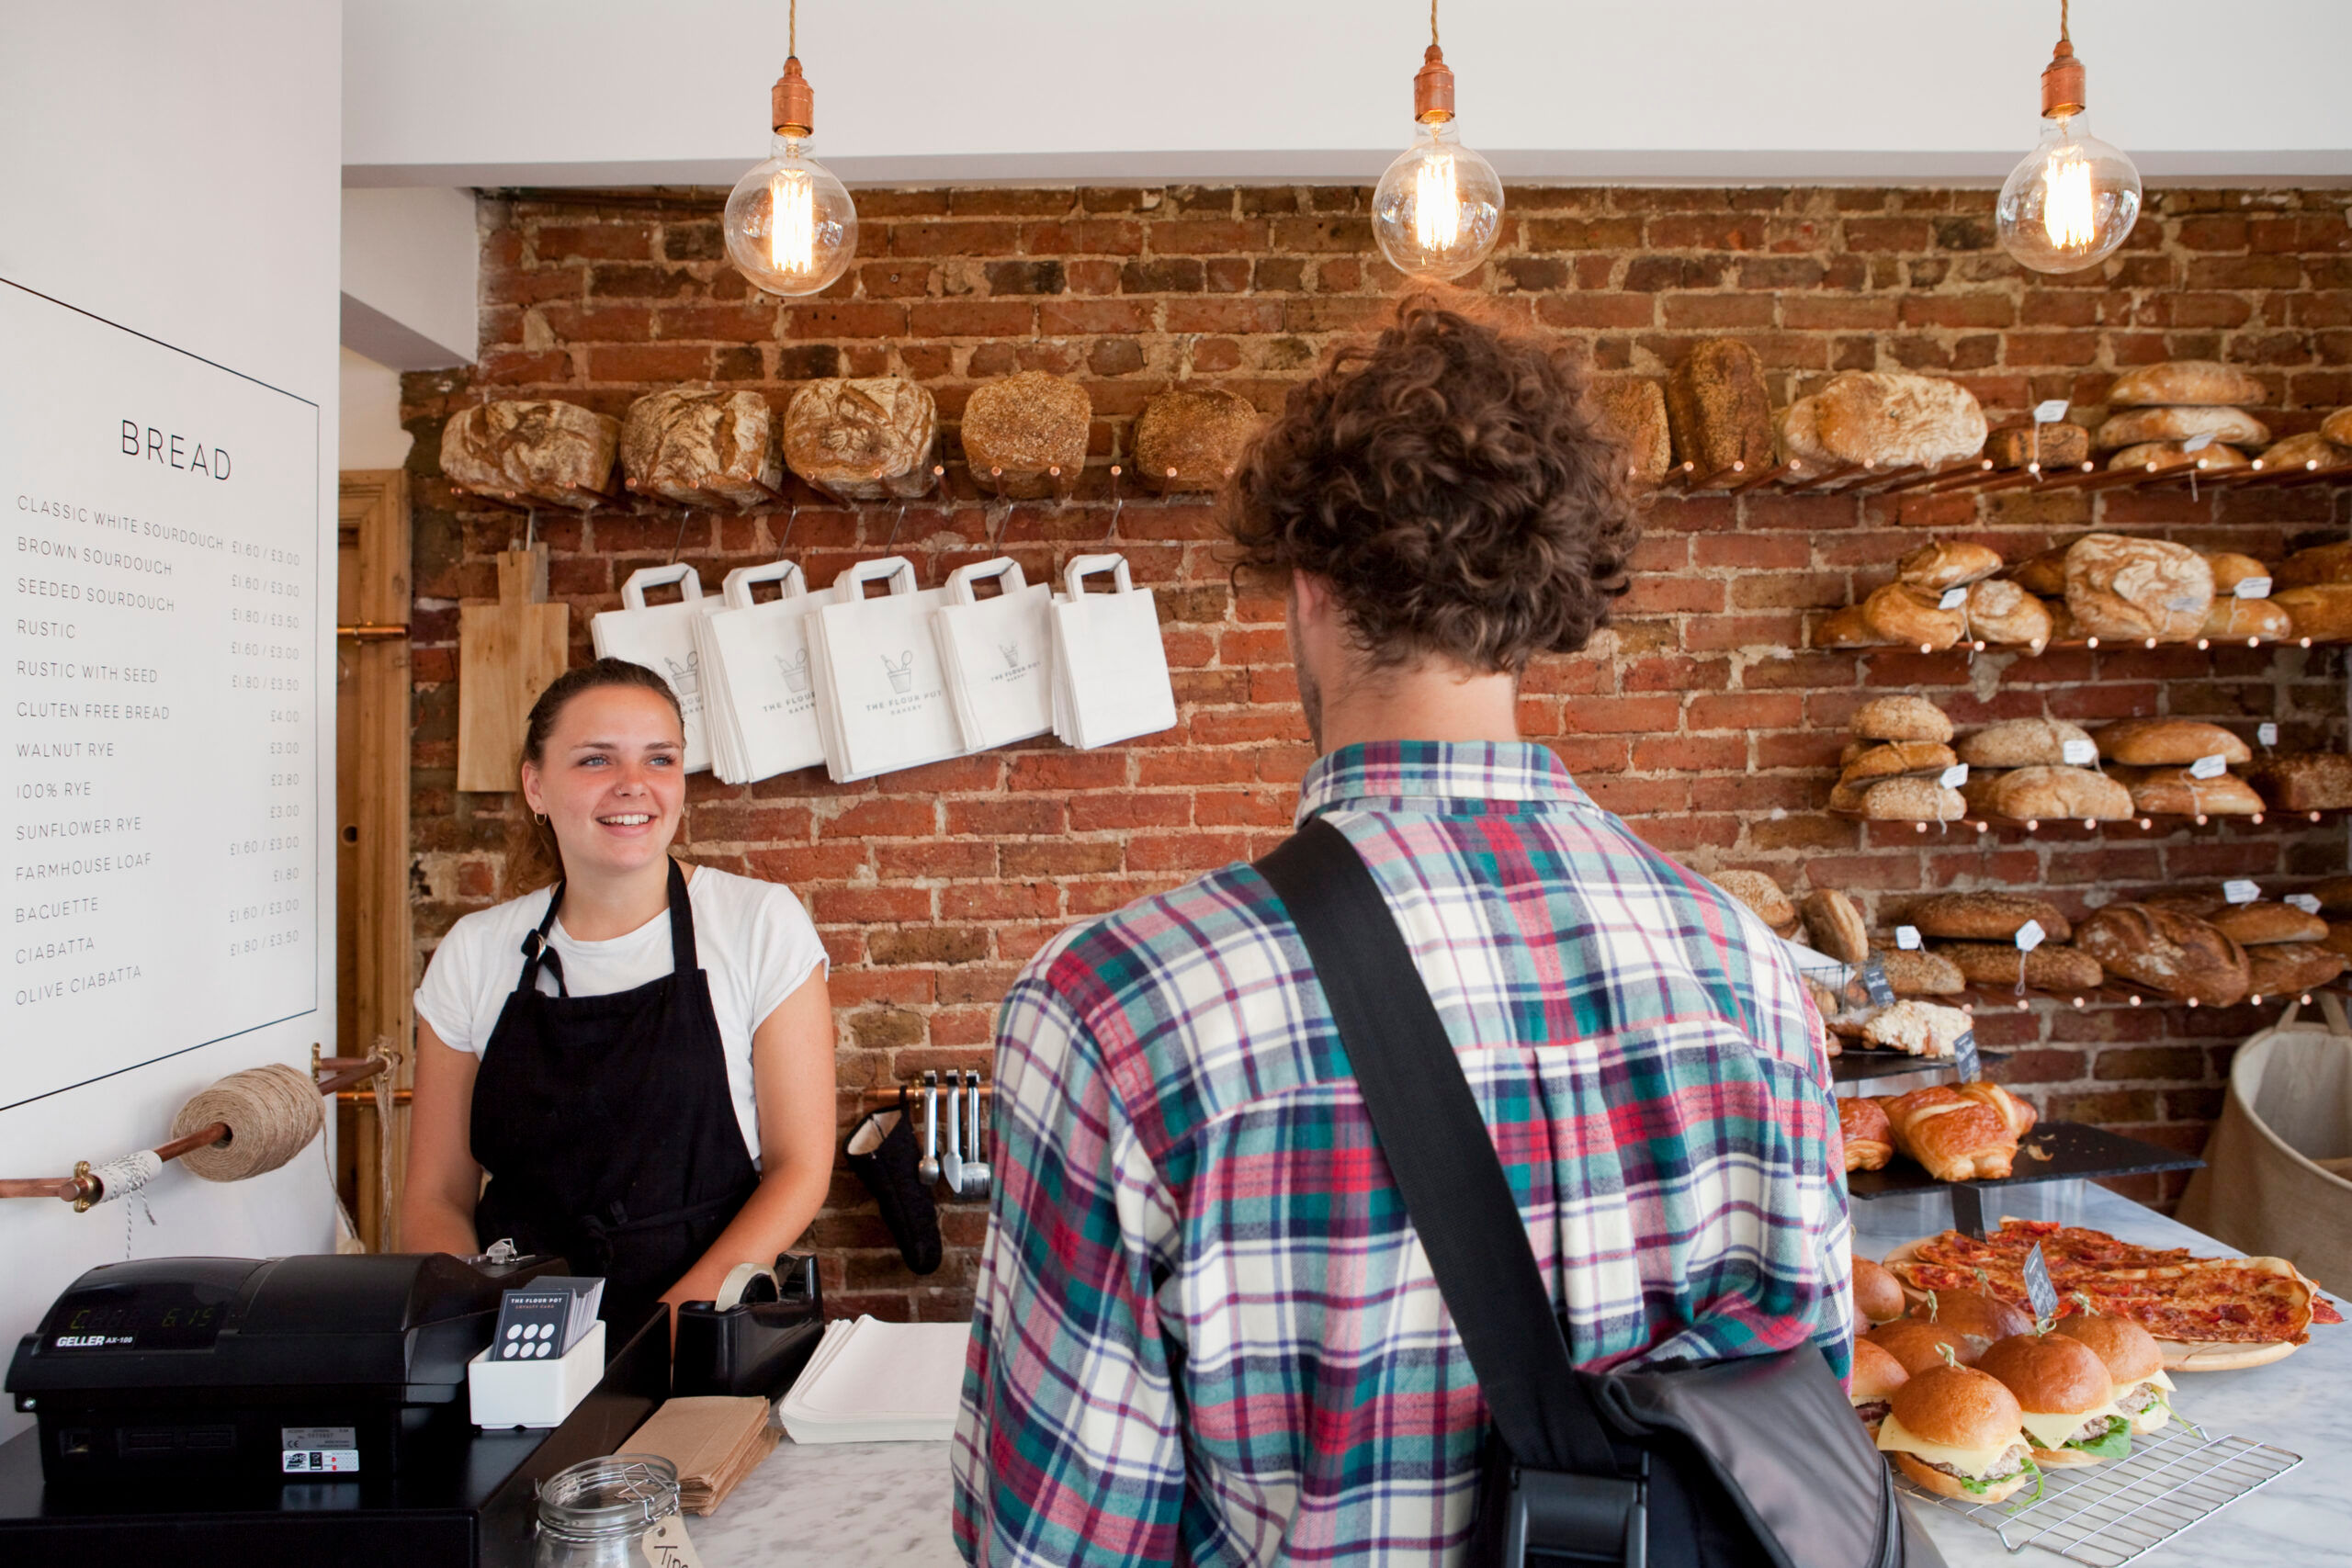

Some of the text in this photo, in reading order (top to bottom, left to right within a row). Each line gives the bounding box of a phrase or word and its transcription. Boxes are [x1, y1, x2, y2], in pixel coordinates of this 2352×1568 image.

[122, 420, 231, 480] BREAD
[17, 495, 87, 522] CLASSIC
[95, 512, 137, 533] WHITE
[144, 522, 223, 550] SOURDOUGH
[18, 536, 76, 558] BROWN
[84, 548, 171, 574] SOURDOUGH
[17, 578, 80, 599] SEEDED
[87, 588, 174, 611] SOURDOUGH
[17, 619, 74, 638] RUSTIC
[17, 660, 74, 678] RUSTIC
[82, 665, 118, 680] WITH
[124, 668, 157, 682] SEED
[85, 705, 119, 718] FREE
[126, 705, 169, 719] BREAD
[763, 703, 782, 712] THE
[865, 702, 885, 712] THE
[17, 743, 81, 757] WALNUT
[89, 743, 113, 756] RYE
[17, 784, 57, 798] 100%
[65, 782, 90, 795] RYE
[17, 819, 110, 840] SUNFLOWER
[118, 817, 141, 830] RYE
[17, 857, 110, 881] FARMHOUSE
[118, 852, 151, 869] LOAF
[15, 897, 97, 923] BAGUETTE
[16, 937, 94, 964] CIABATTA
[16, 982, 62, 1005] OLIVE
[71, 965, 141, 993] CIABATTA
[56, 1336, 133, 1348] GELLER AX-100
